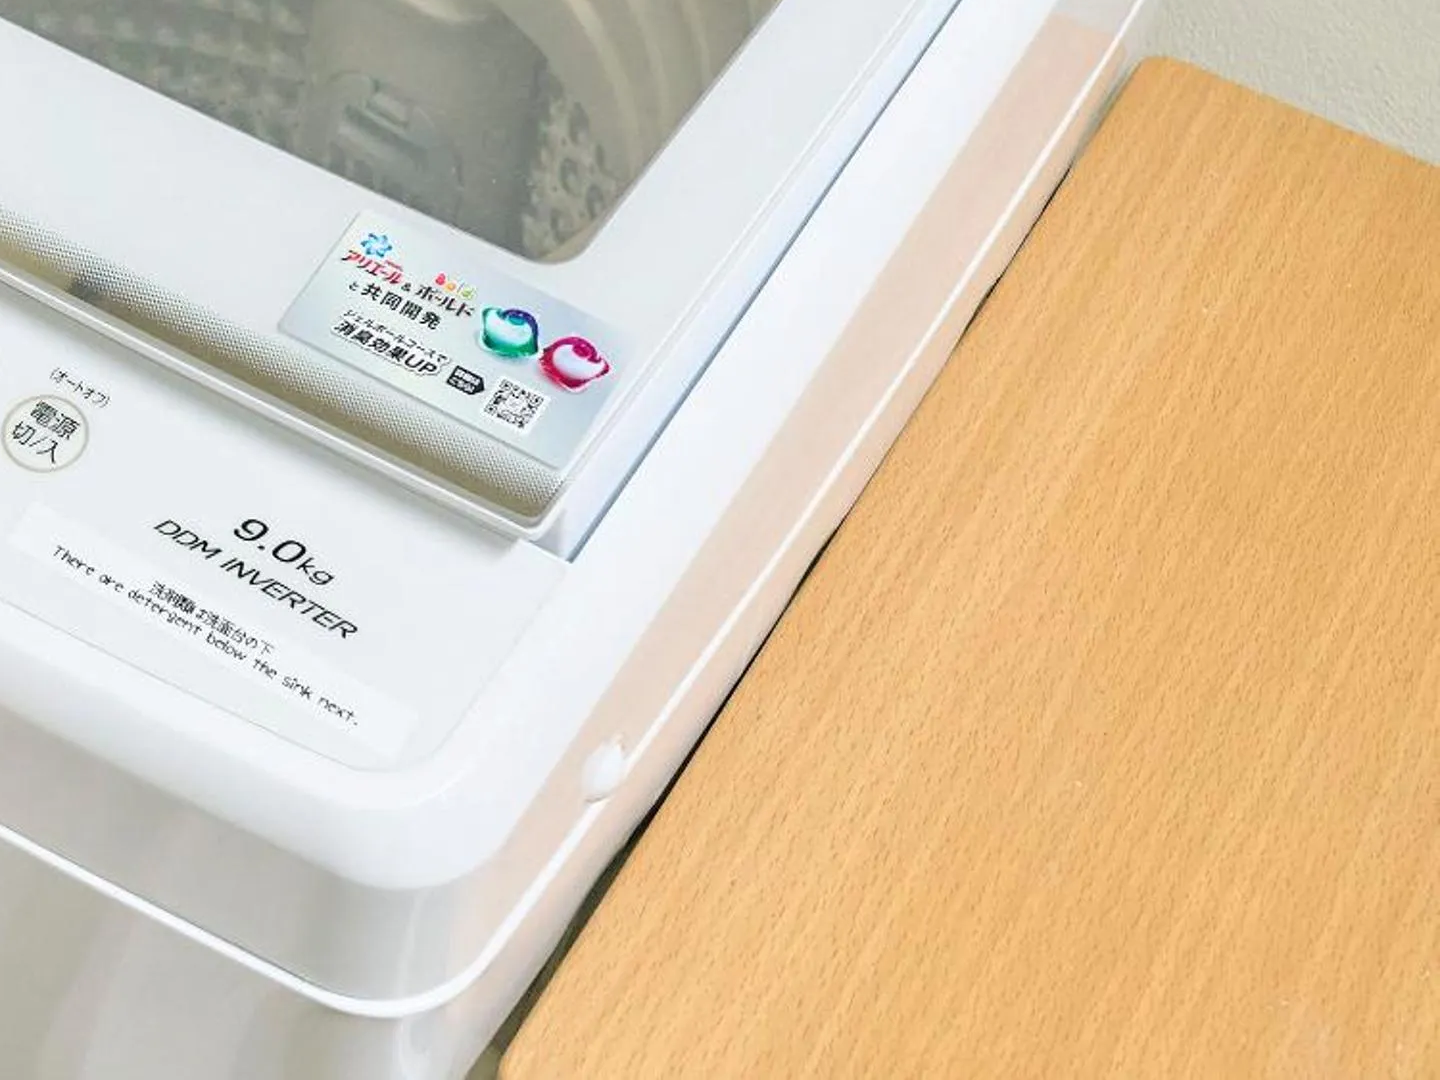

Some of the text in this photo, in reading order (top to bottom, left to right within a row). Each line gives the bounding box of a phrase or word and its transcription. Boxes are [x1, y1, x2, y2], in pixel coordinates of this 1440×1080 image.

[341, 250, 403, 284] アリエール
[415, 285, 475, 317] ボールド
[12, 420, 59, 464] 切/入
[30, 400, 80, 441] 電源
[153, 519, 358, 639] DDM INVERTER
[233, 518, 335, 587] 9.0kg
[52, 545, 96, 577] There
[98, 573, 125, 594] are
[127, 585, 204, 637] detergent
[206, 631, 248, 662] below
[252, 657, 278, 680] the
[280, 673, 314, 701] sink
